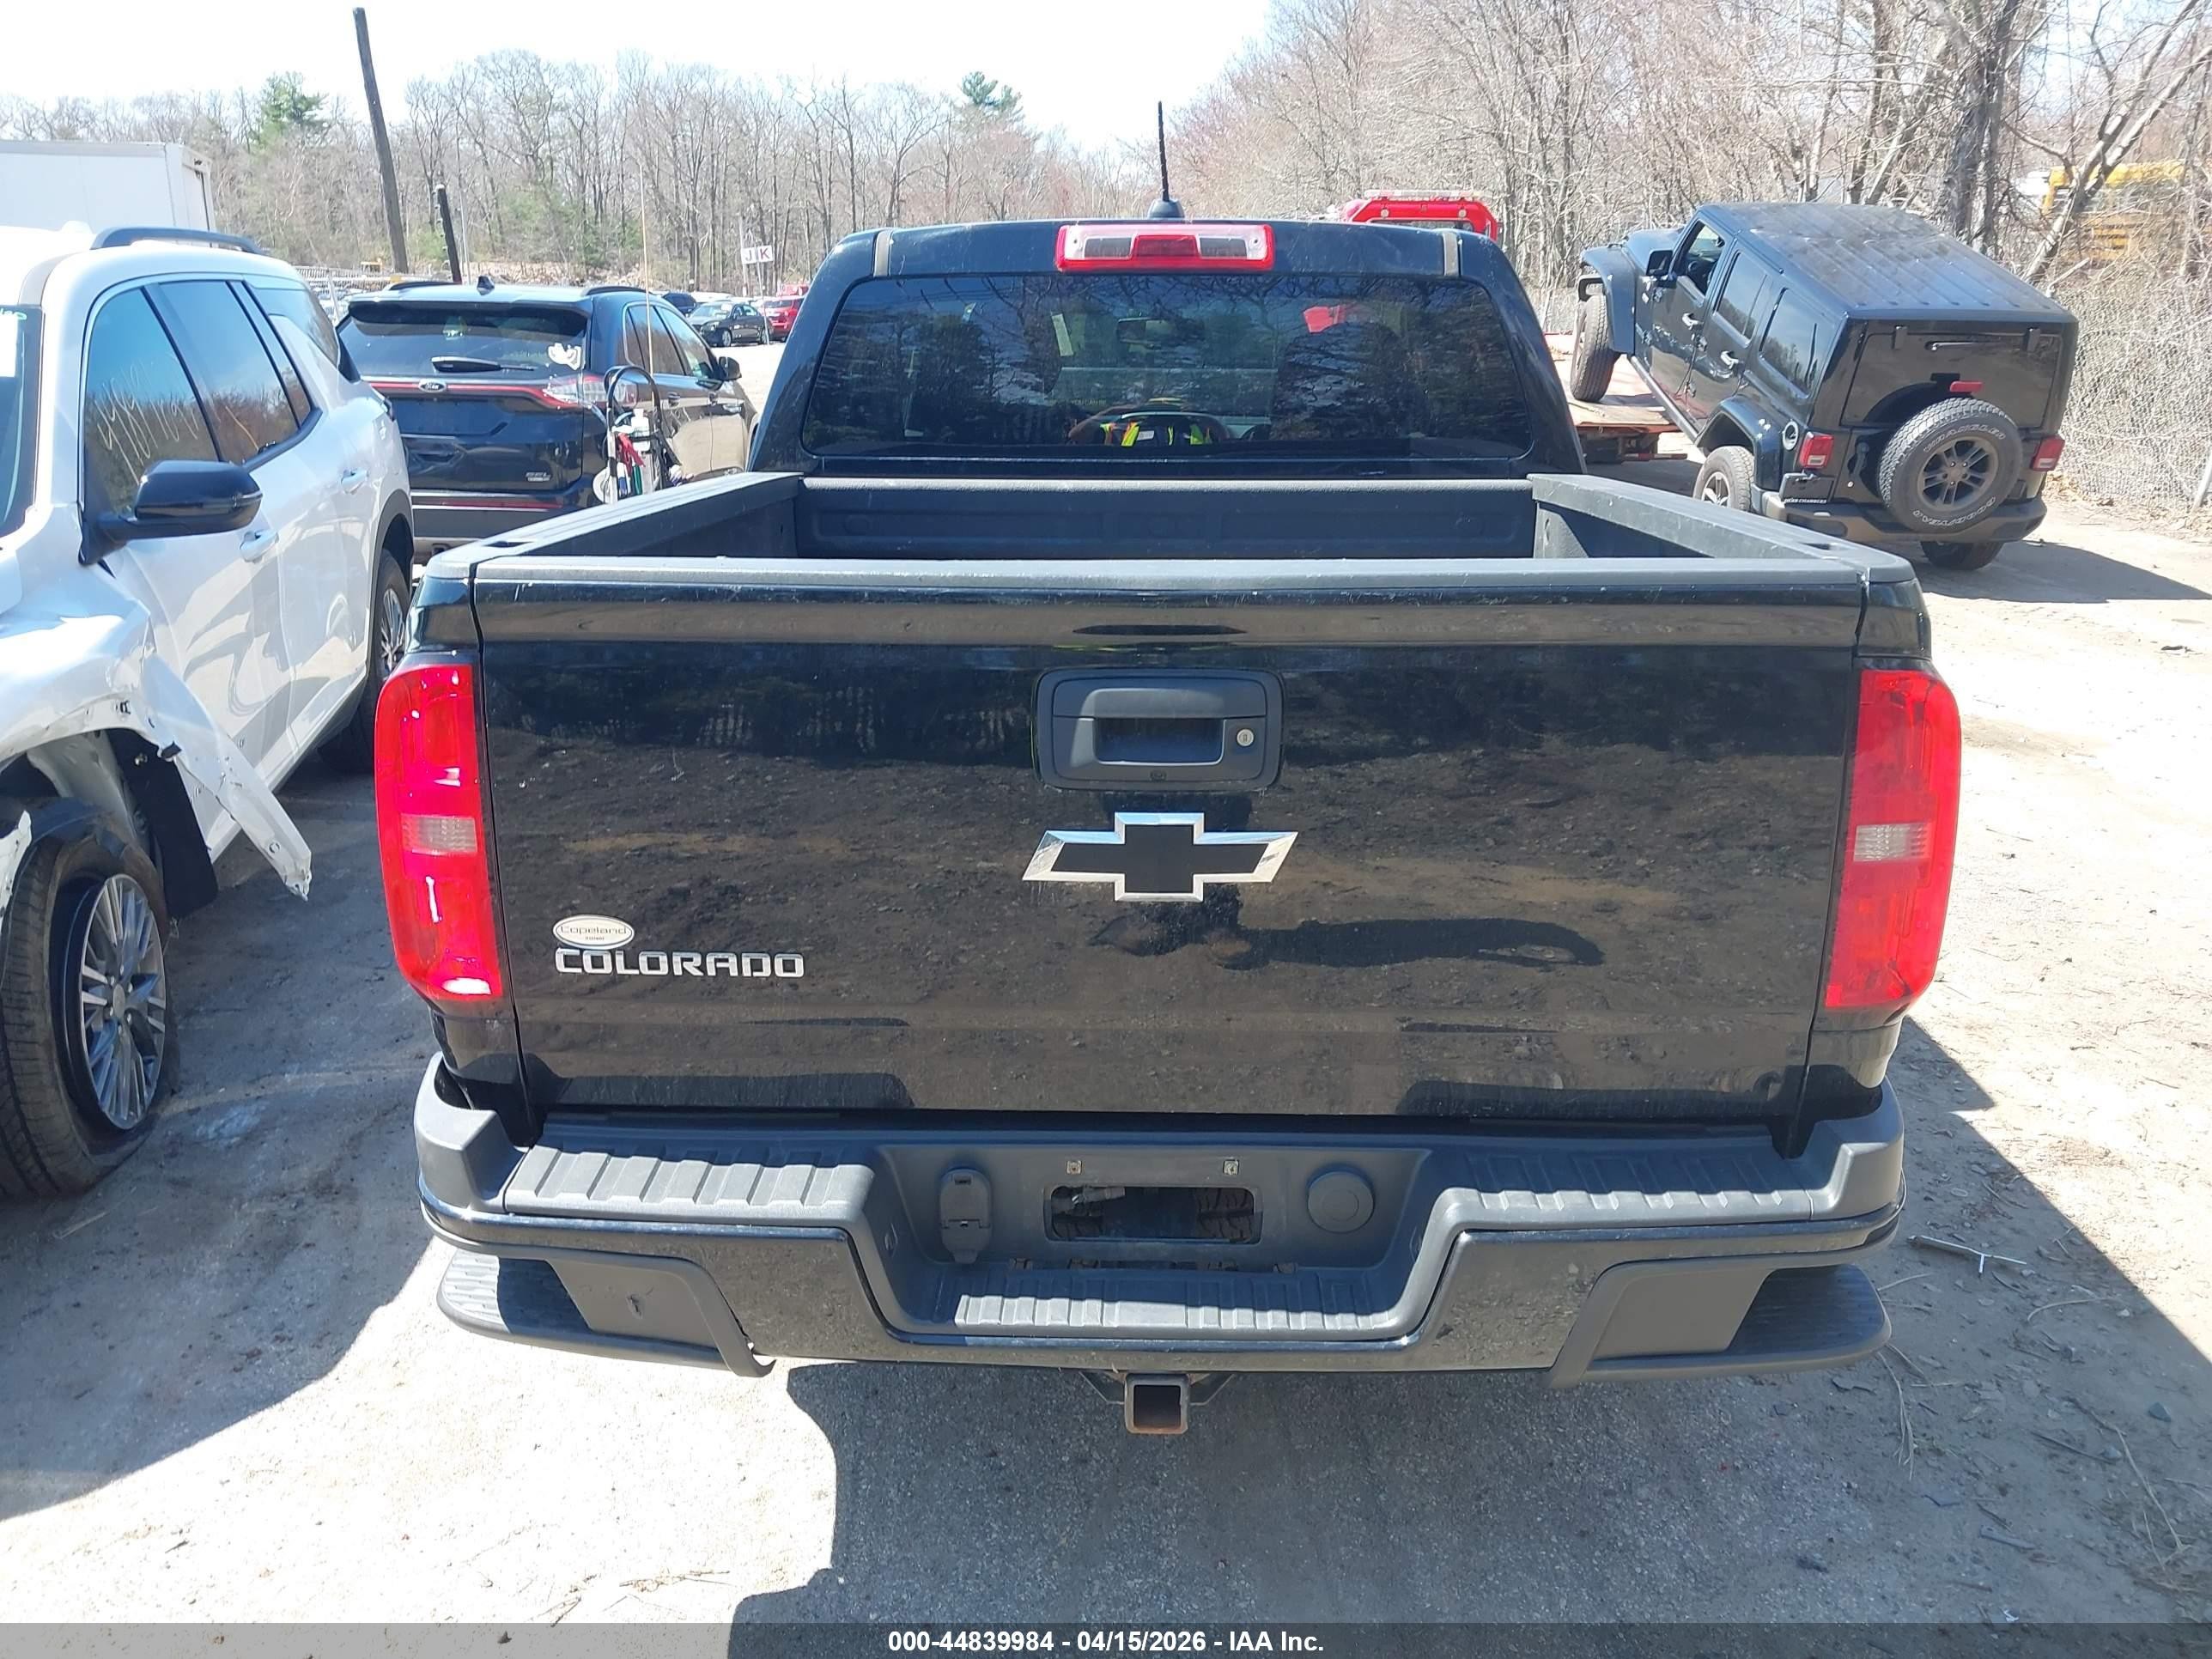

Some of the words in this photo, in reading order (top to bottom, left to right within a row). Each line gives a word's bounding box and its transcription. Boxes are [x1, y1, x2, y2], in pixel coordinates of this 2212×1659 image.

[745, 250, 752, 261] J
[759, 248, 770, 260] K
[1912, 496, 1996, 526] GOODYEAR
[560, 926, 627, 935] Copeland
[555, 947, 805, 978] COLORADO
